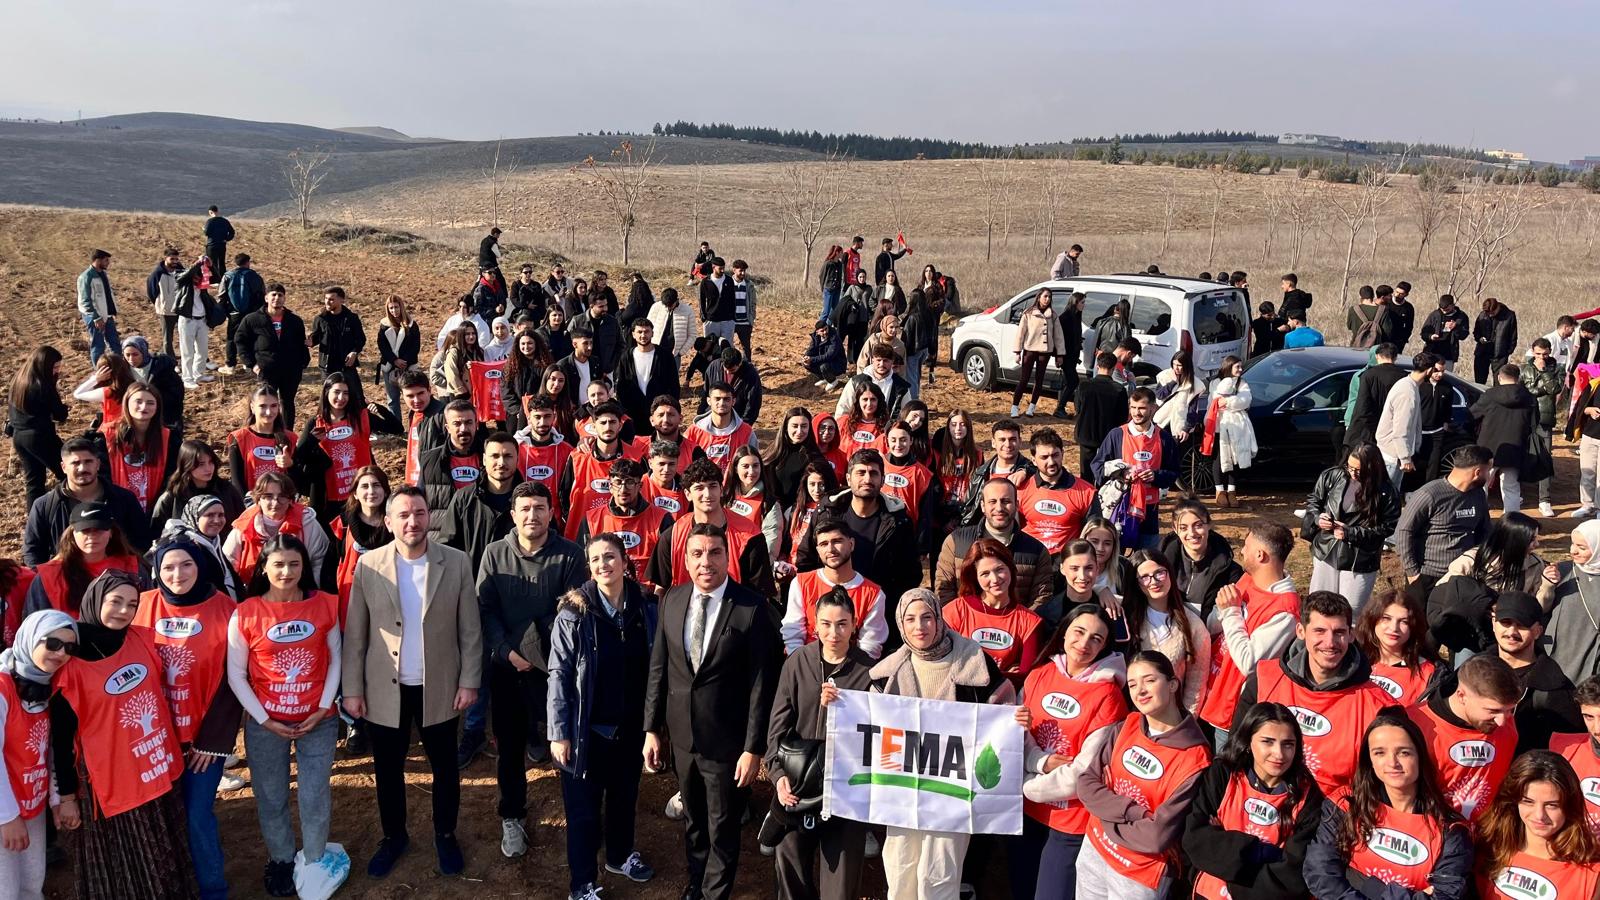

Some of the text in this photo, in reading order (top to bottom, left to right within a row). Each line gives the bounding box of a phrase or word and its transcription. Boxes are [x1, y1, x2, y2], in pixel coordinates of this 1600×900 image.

[331, 428, 346, 436] TEMA
[857, 432, 869, 440] TEMA
[260, 447, 274, 456] TEMA
[888, 475, 902, 483] TEMA
[658, 498, 673, 508] TEMA
[1041, 502, 1057, 510] TEMA
[1456, 506, 1476, 518] mavi
[165, 620, 189, 630] TEMA
[276, 623, 302, 634] TEMA
[981, 631, 1002, 642] TEMA
[114, 669, 135, 687] TEMA
[1049, 695, 1069, 711] TEMA
[1295, 709, 1317, 728] TEMA
[857, 723, 967, 780] TEMA
[1460, 745, 1485, 758] TEMA
[1130, 748, 1150, 770] TEMA
[1591, 780, 1600, 792] TE
[1249, 801, 1267, 817] TEMA
[1378, 831, 1409, 854] TEMA
[1506, 869, 1538, 892] TEMA
